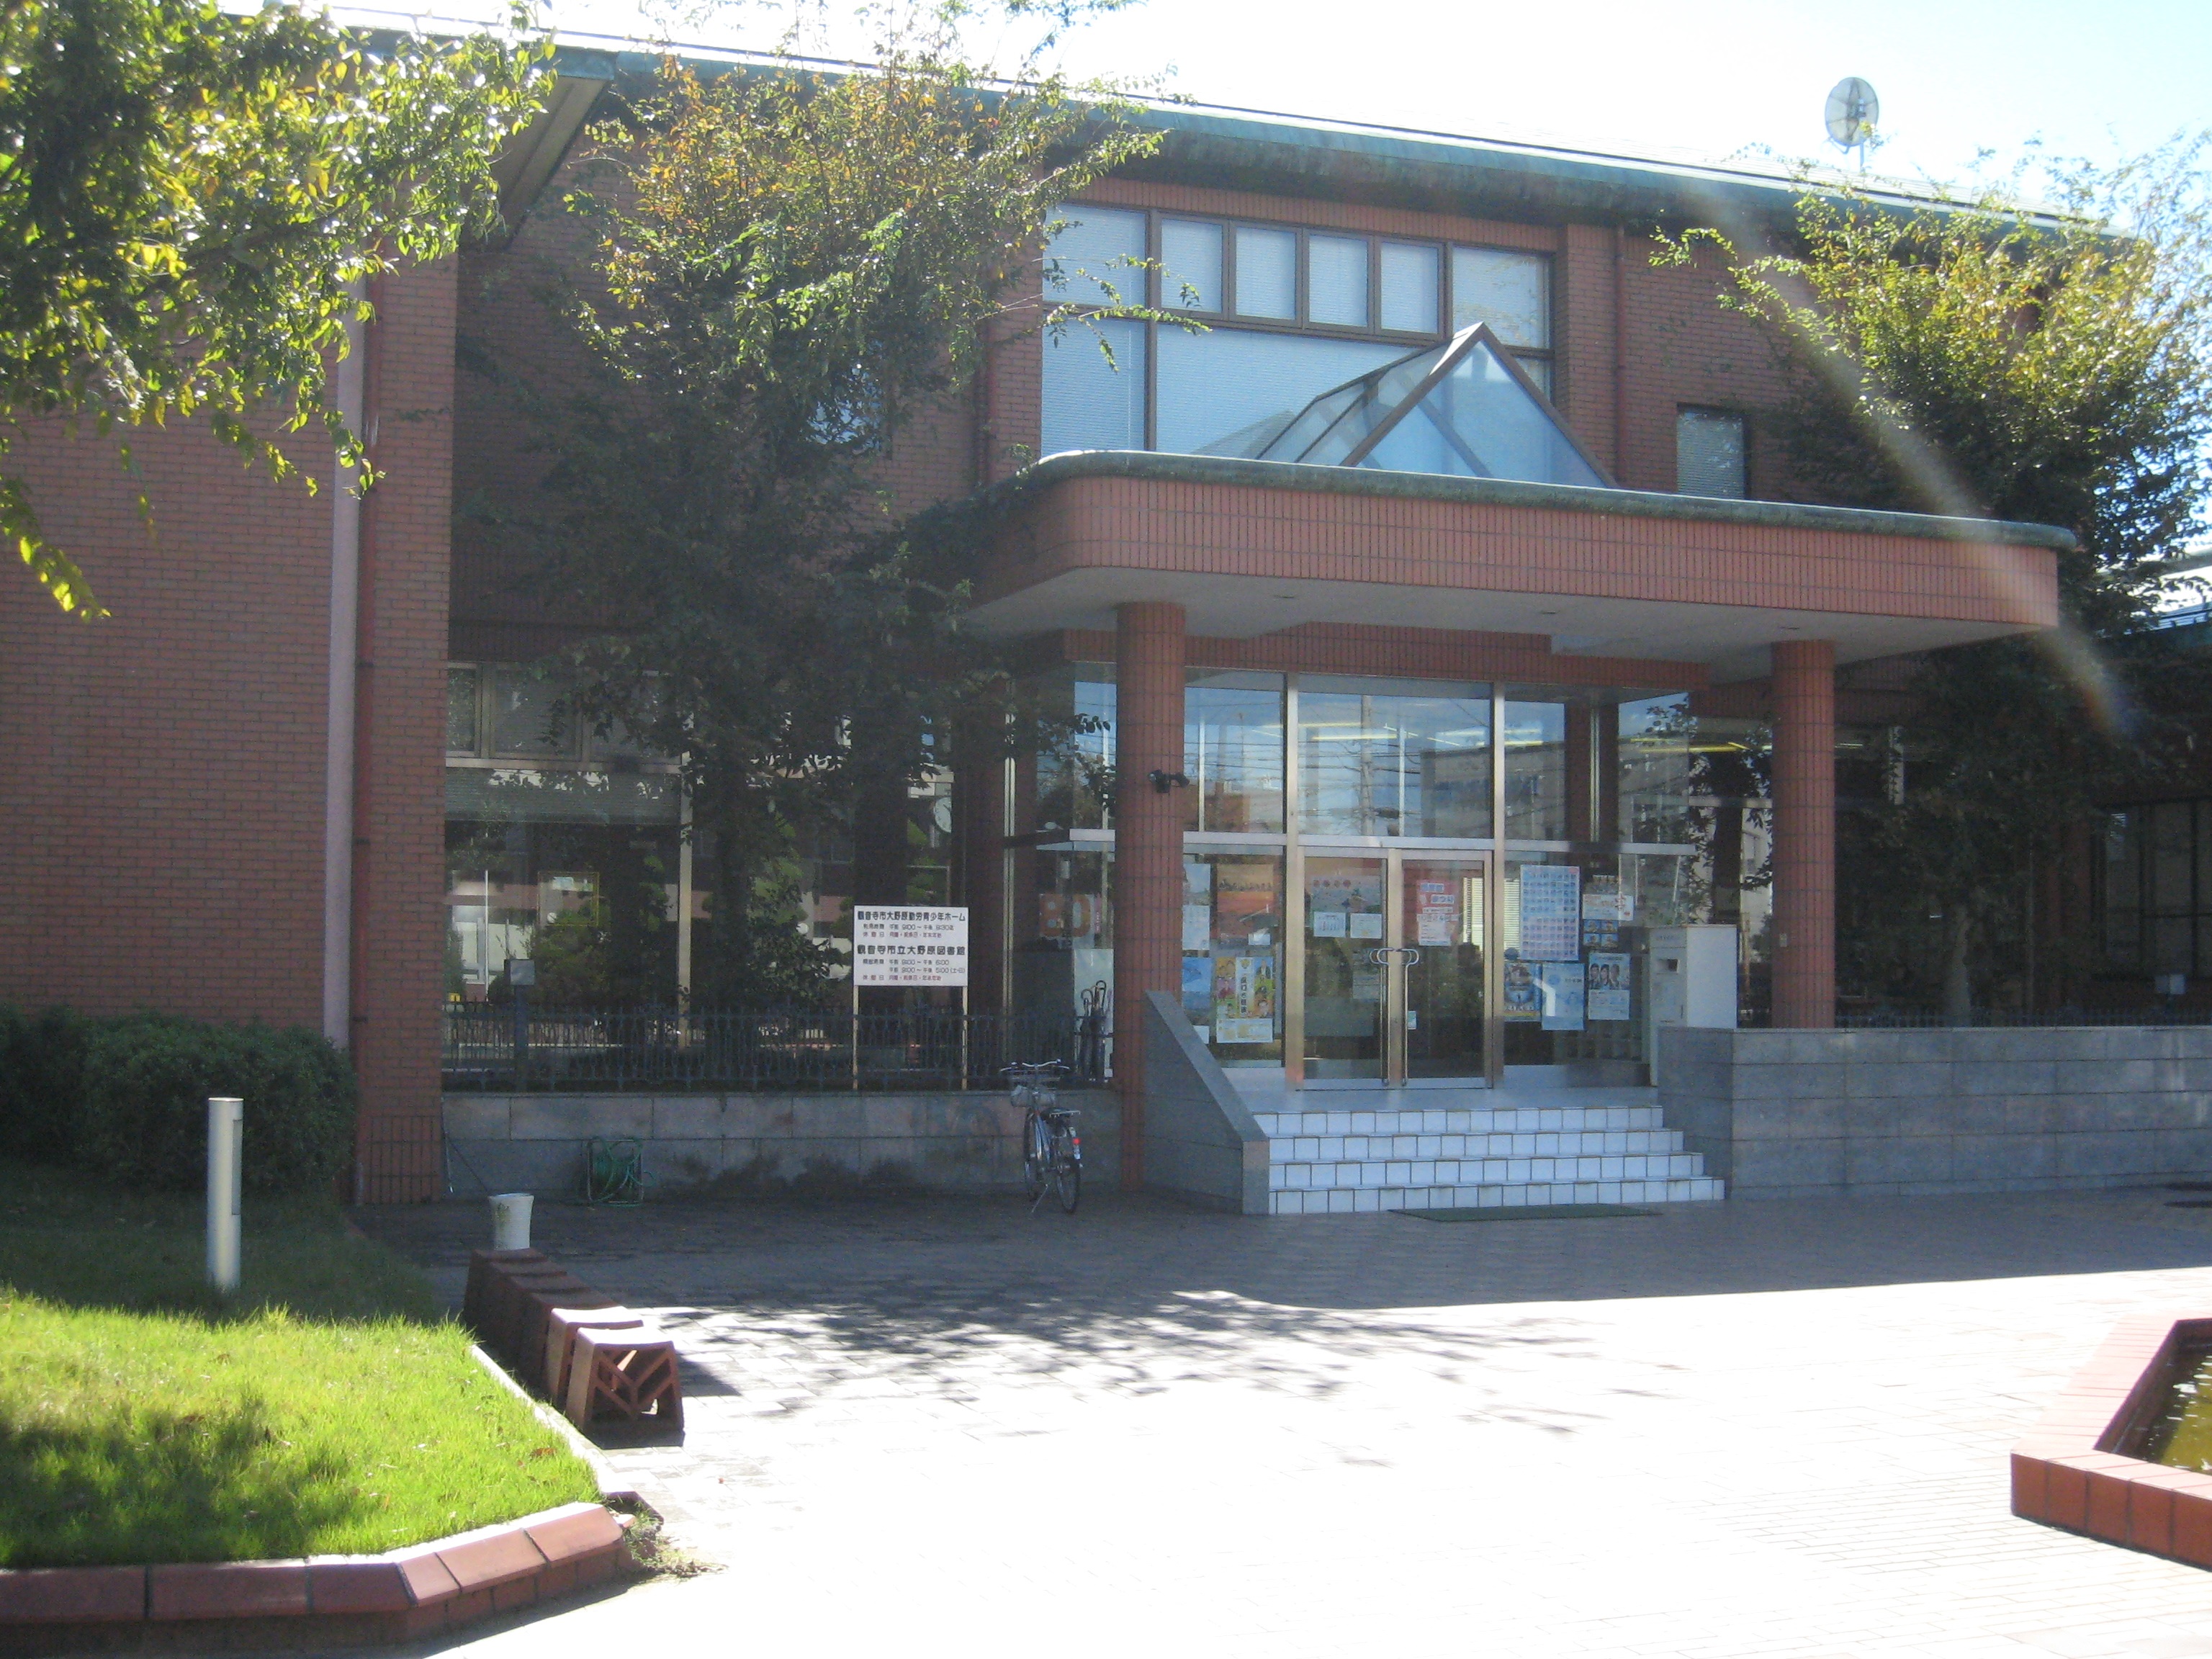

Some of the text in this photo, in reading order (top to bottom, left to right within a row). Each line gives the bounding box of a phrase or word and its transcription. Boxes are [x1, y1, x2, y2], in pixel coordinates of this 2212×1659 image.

[857, 911, 966, 922] 観音寺市大野原勤労青少年ホーム
[857, 945, 966, 956] 観音寺市立大野原図書館
